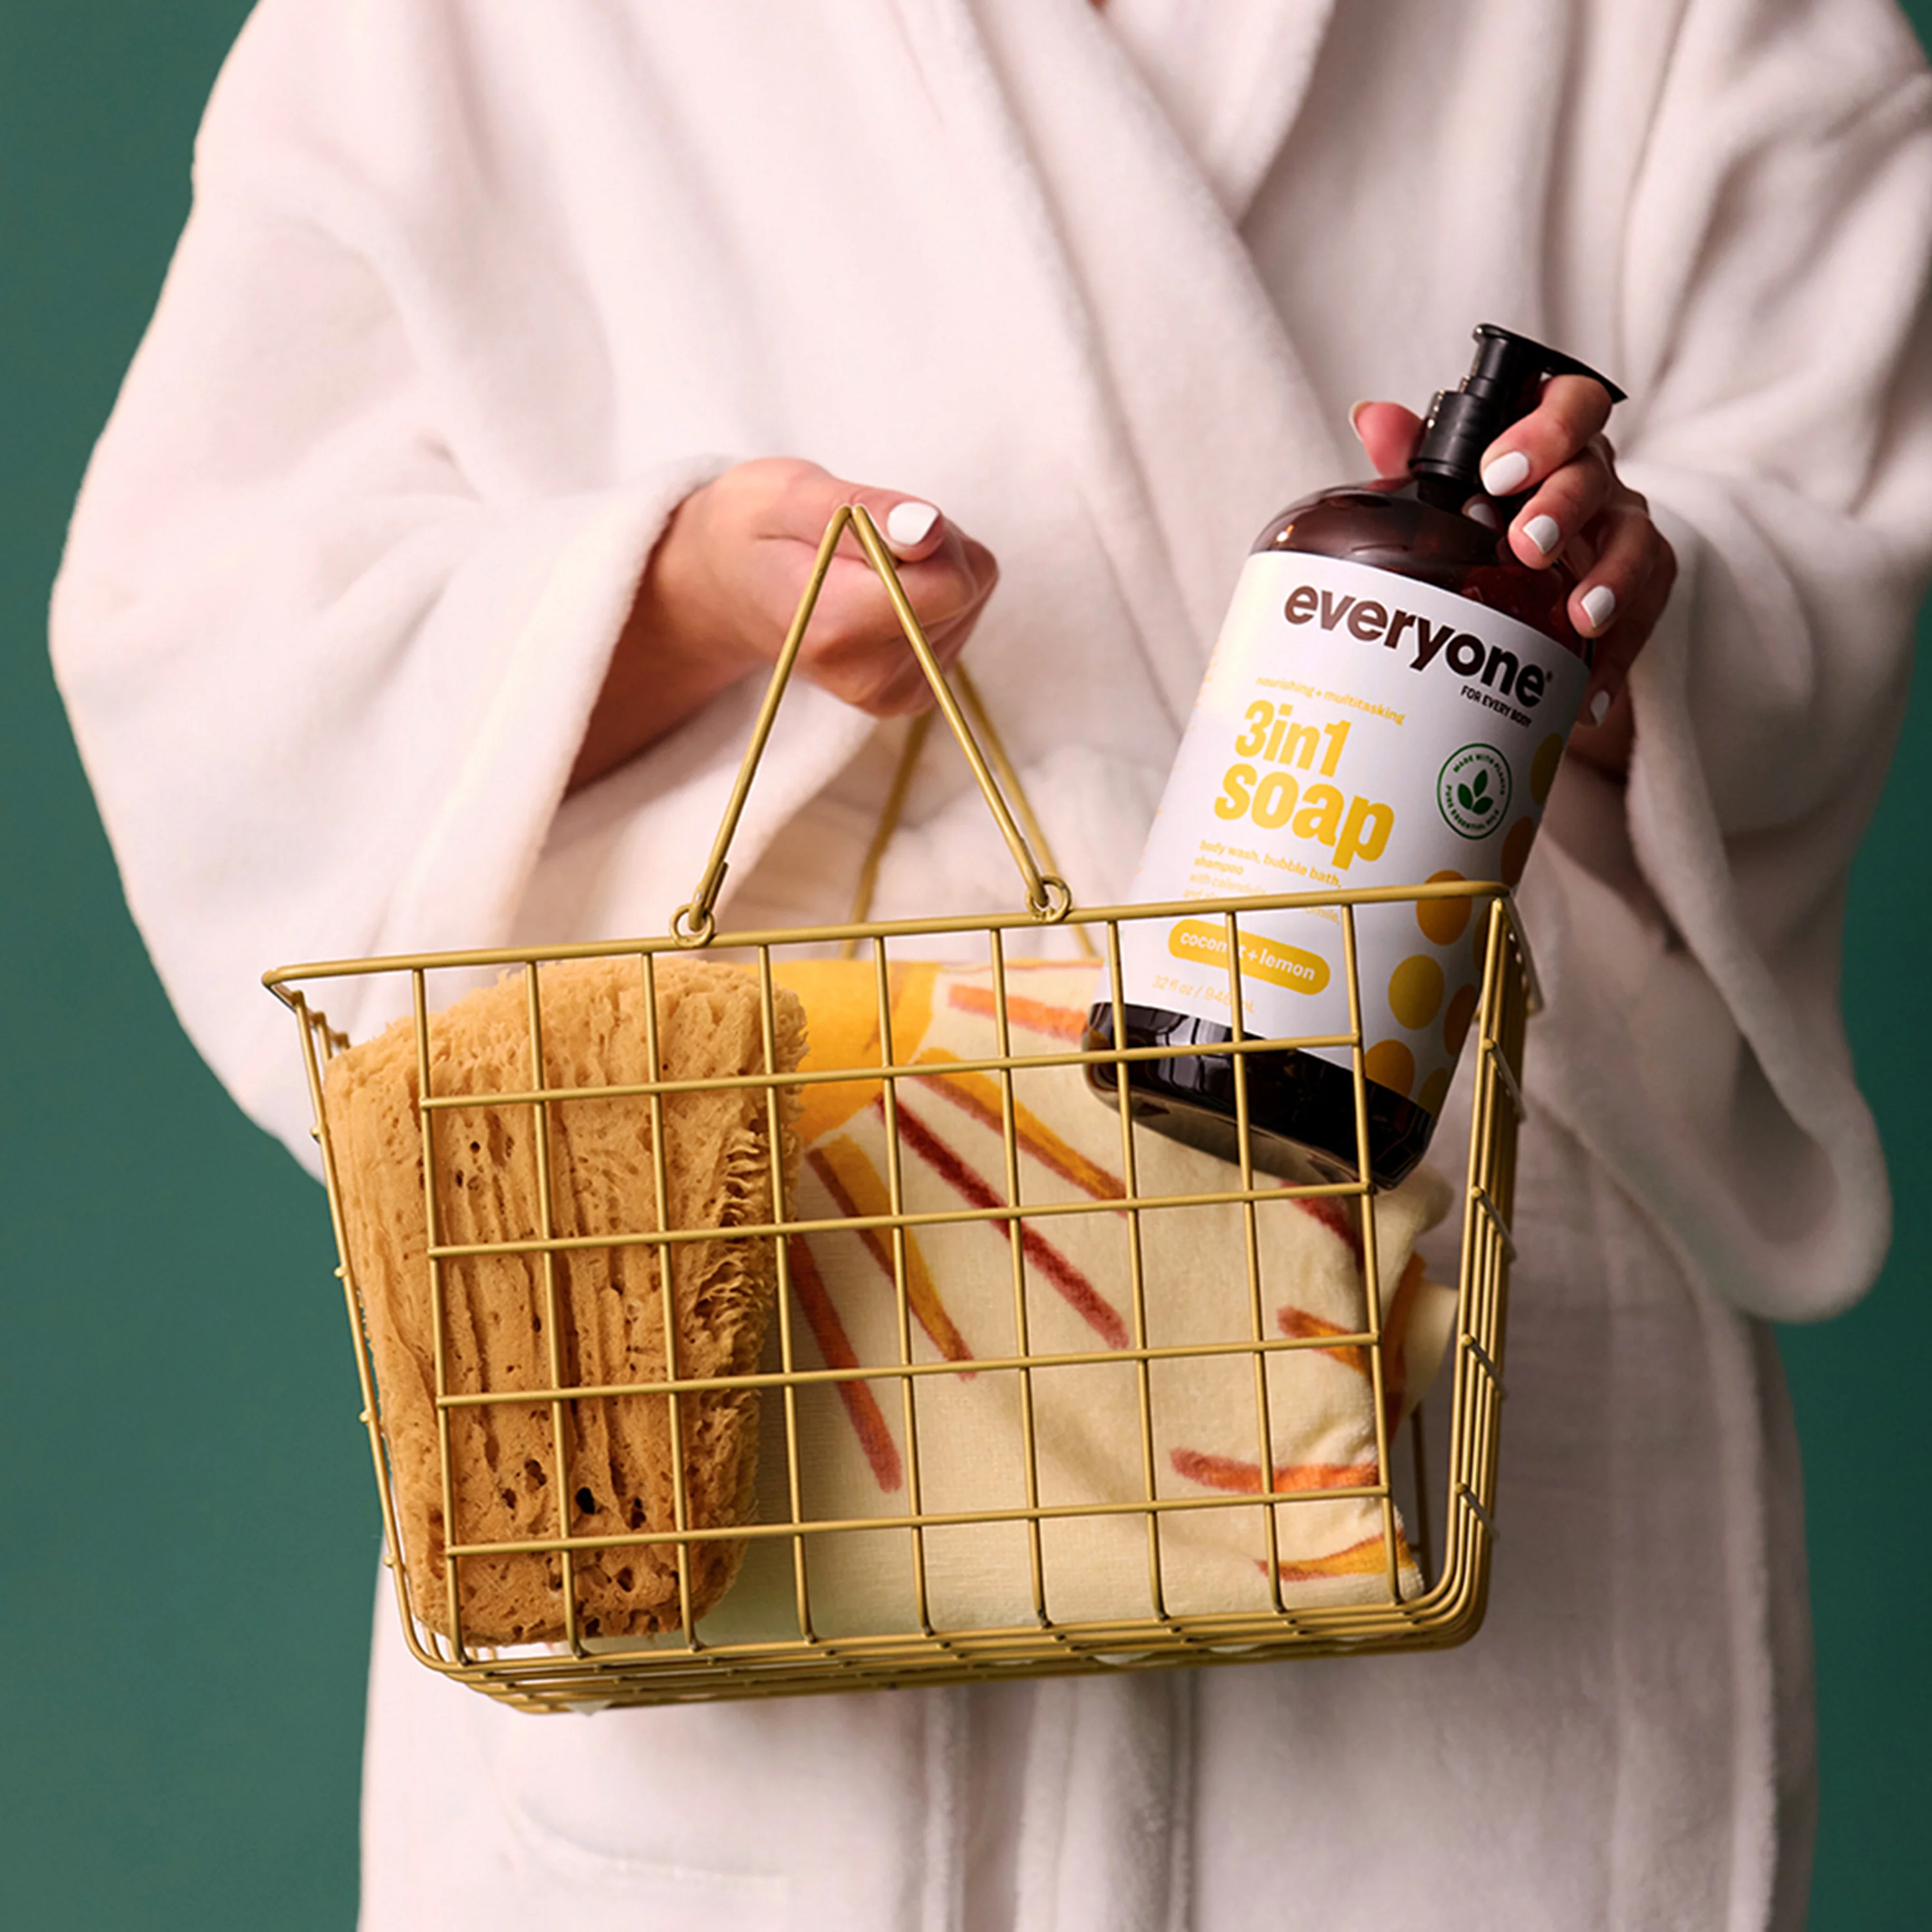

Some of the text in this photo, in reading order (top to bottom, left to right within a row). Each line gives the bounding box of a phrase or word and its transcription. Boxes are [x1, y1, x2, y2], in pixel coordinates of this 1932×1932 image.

[1284, 585, 1545, 708] everyone
[1255, 677, 1315, 698] nourishing
[1323, 691, 1406, 726] multitasking
[1461, 685, 1533, 728] FOR EVERY BODY
[1235, 699, 1351, 777] 3in1
[1214, 762, 1395, 871] soap
[1193, 856, 1244, 876] shampoo
[1199, 839, 1342, 889] body wash, bubble bath,
[1180, 931, 1247, 959] cocont
[1259, 948, 1316, 981] lemon
